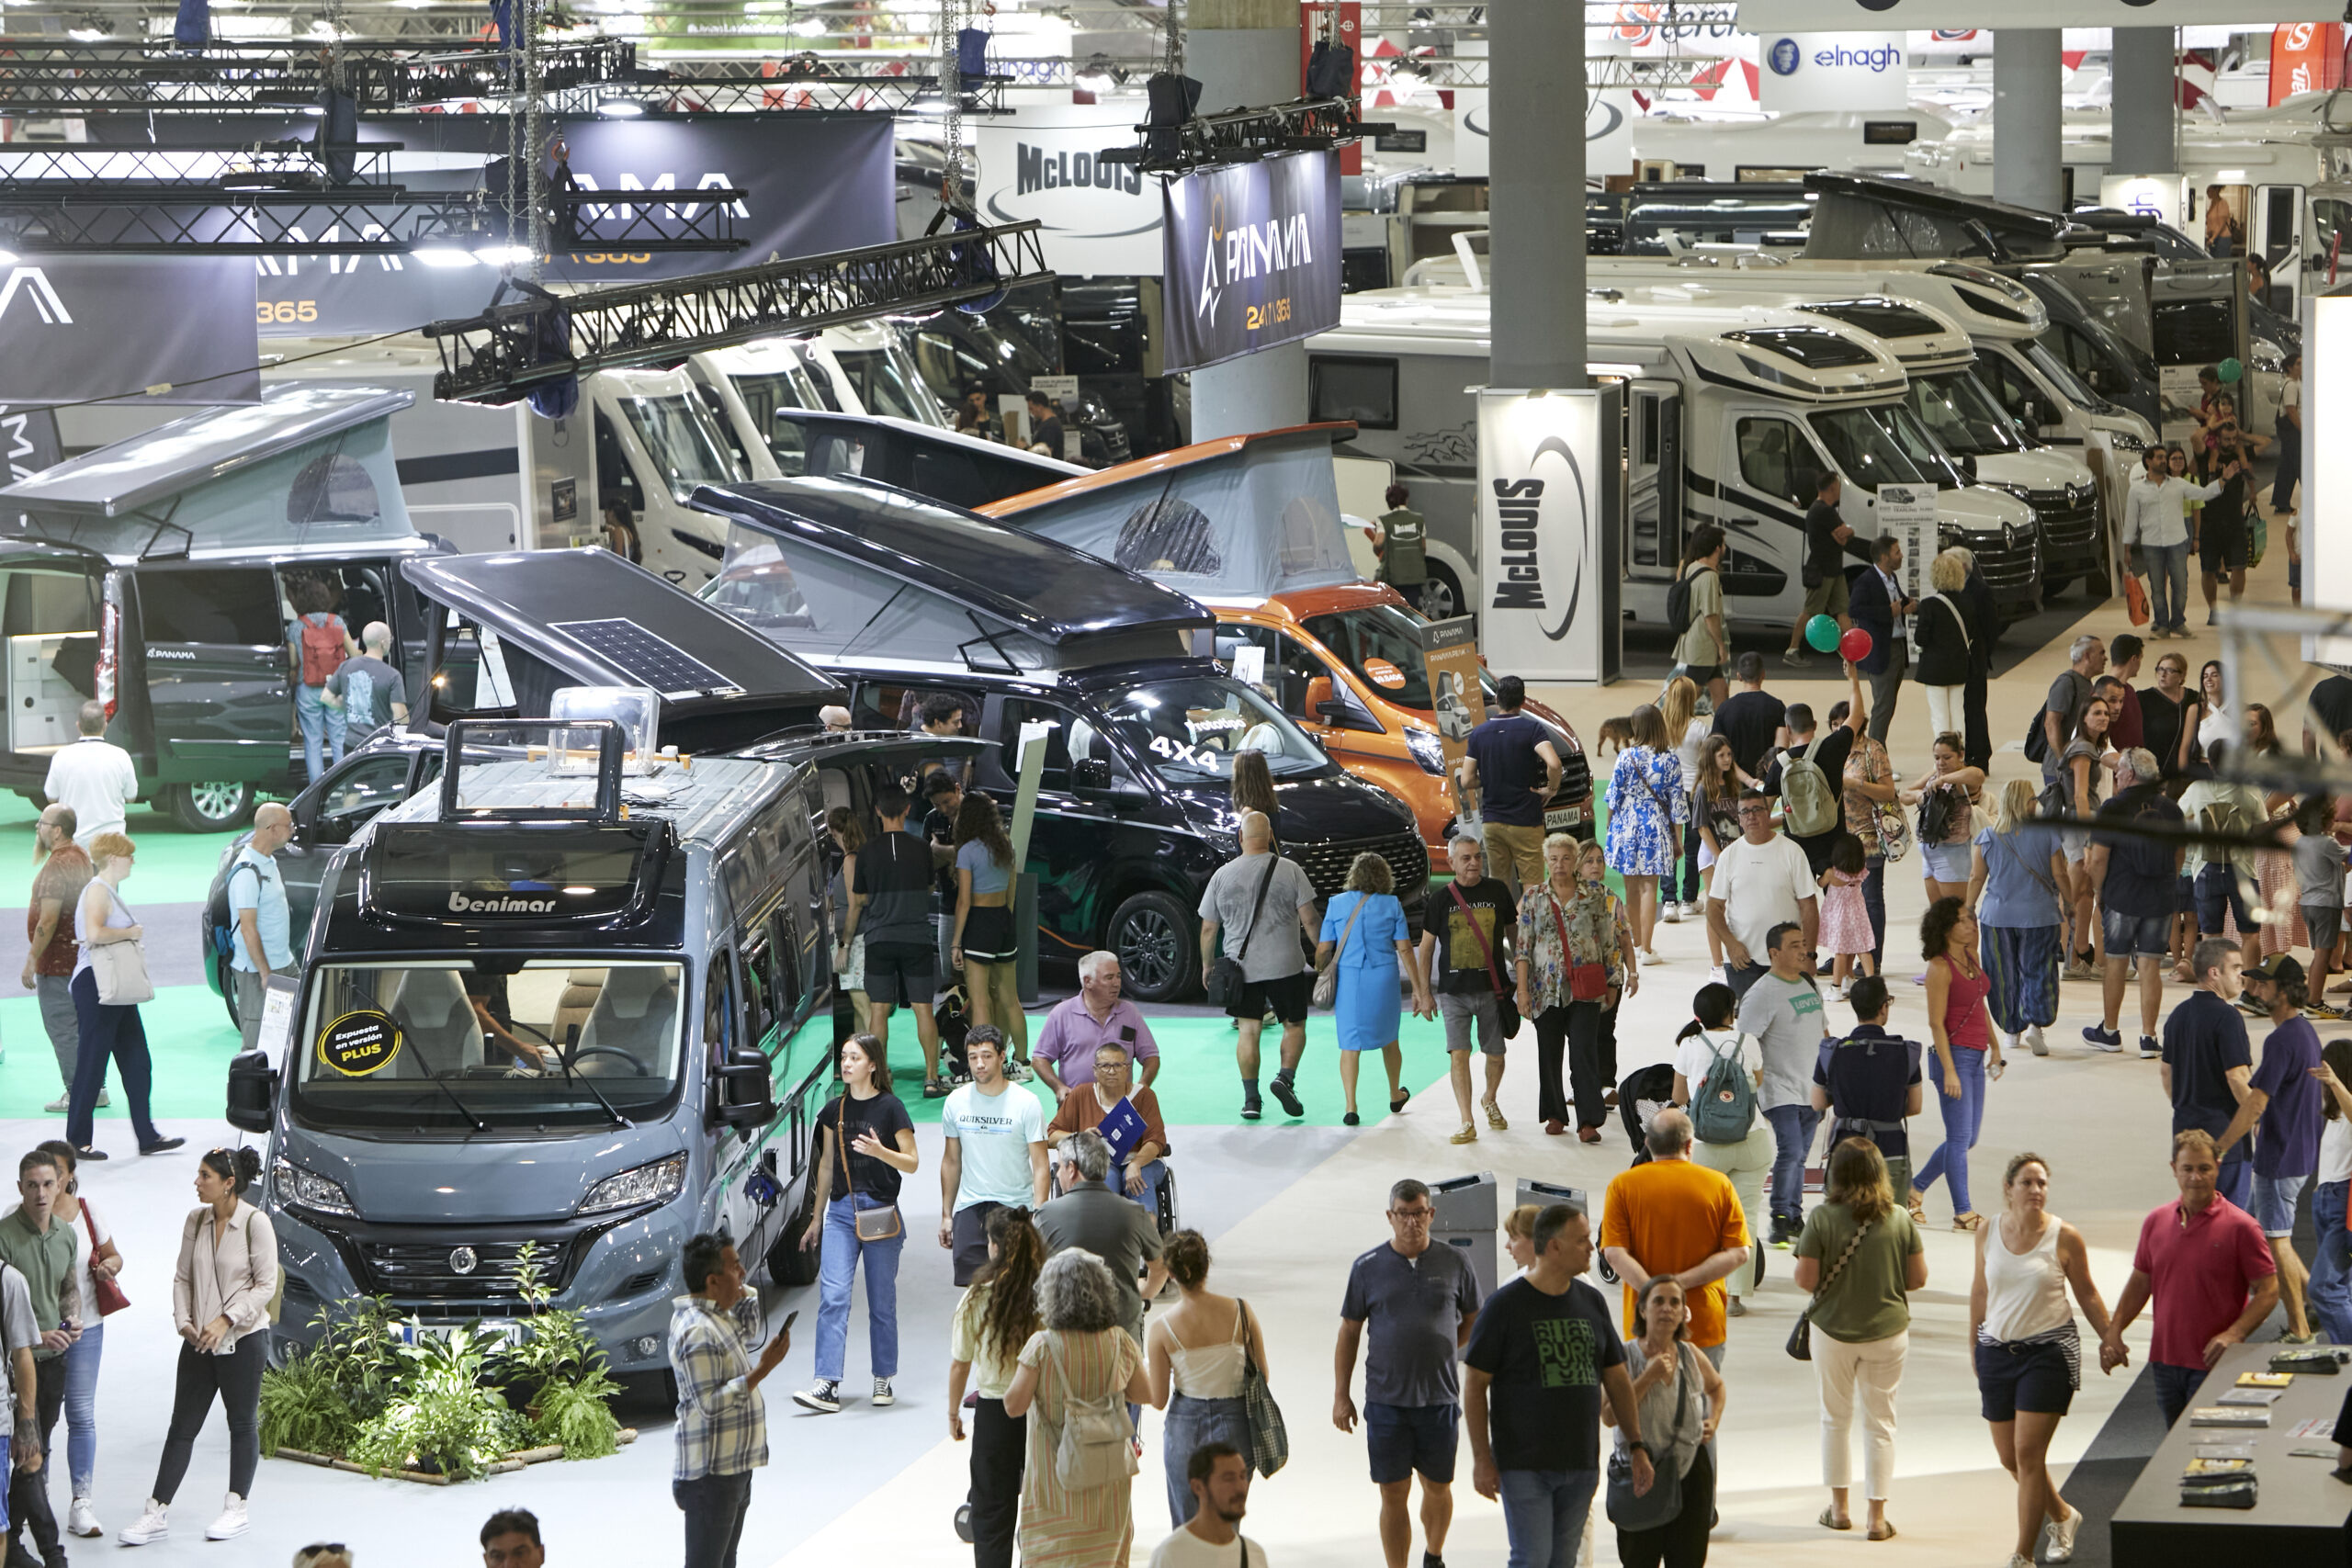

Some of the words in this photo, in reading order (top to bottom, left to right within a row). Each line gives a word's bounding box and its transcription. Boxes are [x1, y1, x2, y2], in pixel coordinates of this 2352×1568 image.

[1814, 42, 1900, 73] elnagh
[1227, 212, 1312, 285] PANAMA
[1492, 478, 1547, 609] McLOUIS
[1440, 626, 1464, 638] PANAMA
[155, 649, 197, 660] PANAMA
[1546, 810, 1579, 826] PANAMA
[448, 891, 557, 912] benimar
[335, 1024, 379, 1041] Expuesta
[335, 1042, 347, 1050] en
[348, 1032, 382, 1046] versión
[341, 1043, 381, 1062] PLUS
[959, 1114, 1012, 1125] QUIKSILVER
